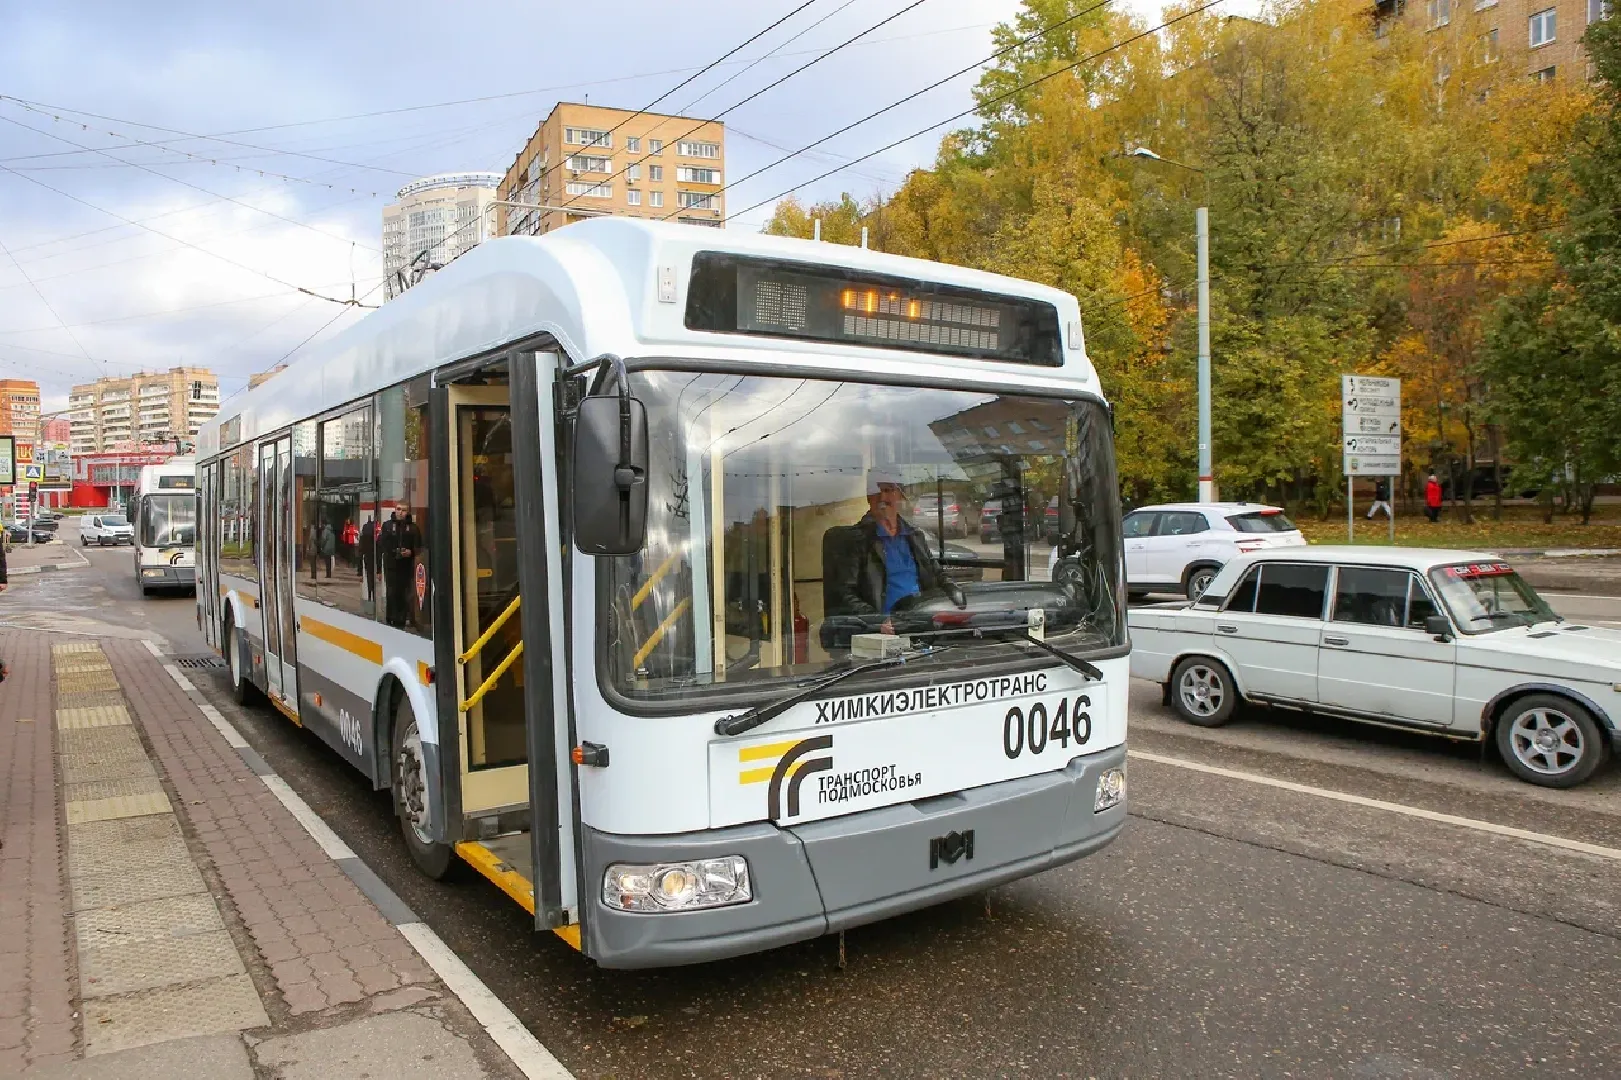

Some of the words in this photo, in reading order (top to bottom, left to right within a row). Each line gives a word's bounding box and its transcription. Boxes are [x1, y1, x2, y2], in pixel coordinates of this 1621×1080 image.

[816, 673, 1047, 725] ХИМКИЭЛЕКТРОТРАНС
[339, 708, 363, 756] 0046
[1004, 695, 1093, 760] 0046
[818, 764, 897, 792] ТРАНСПОРТ
[818, 772, 922, 805] ПОДМОСКОВЬЯ
